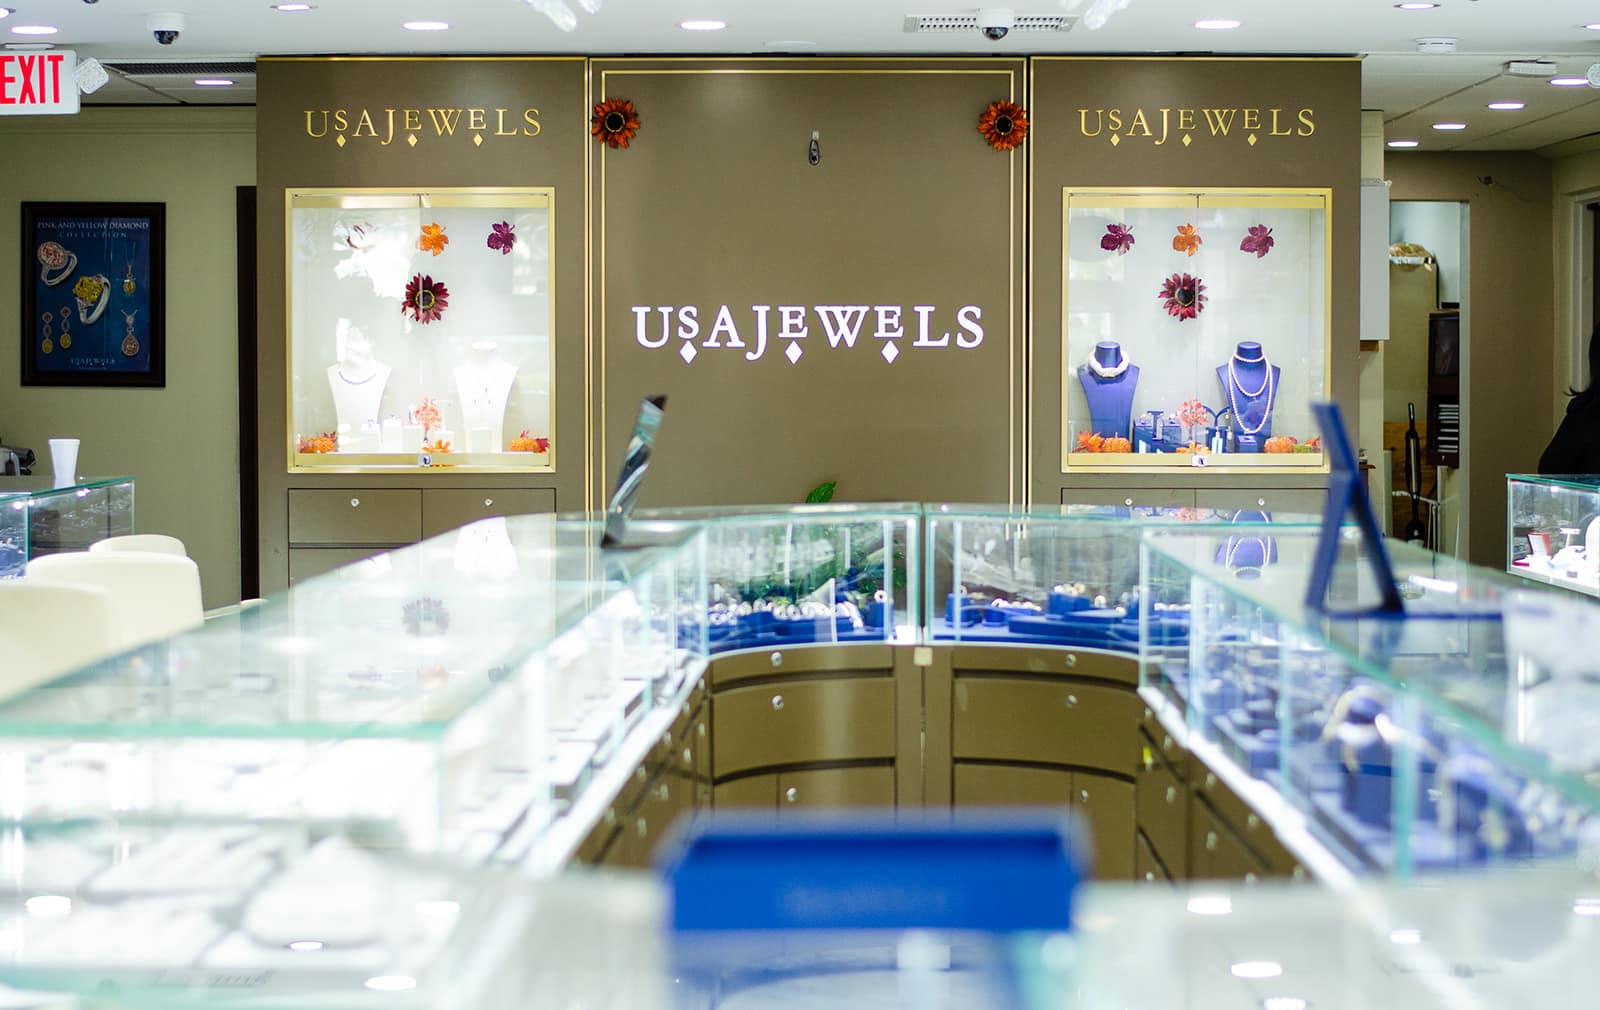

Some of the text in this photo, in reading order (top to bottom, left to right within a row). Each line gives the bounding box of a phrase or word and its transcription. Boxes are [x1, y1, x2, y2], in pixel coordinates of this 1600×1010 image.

[0, 54, 64, 105] EXIT
[303, 108, 541, 146] USAJEWELS
[1077, 108, 1316, 146] USAJEWELS
[38, 221, 149, 229] PINK AND YELLOW DIAMOND
[631, 304, 985, 361] USAJEWELS
